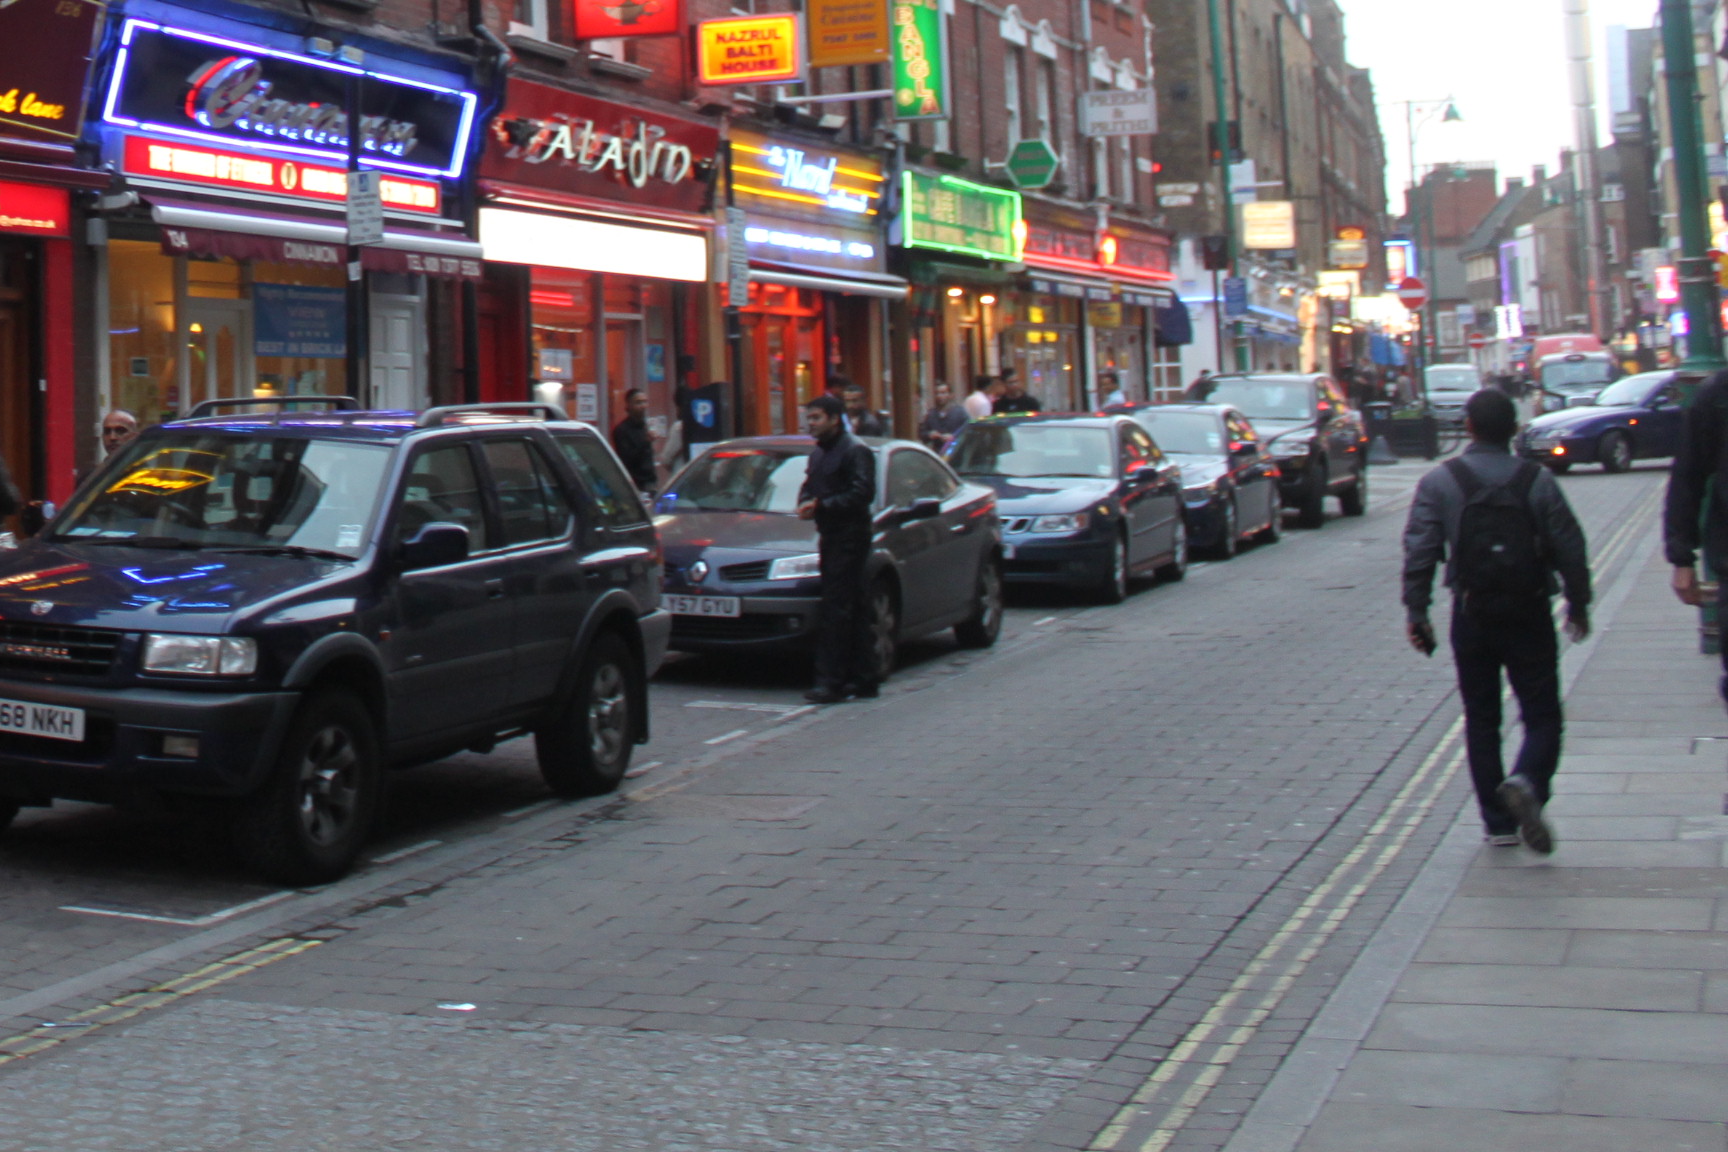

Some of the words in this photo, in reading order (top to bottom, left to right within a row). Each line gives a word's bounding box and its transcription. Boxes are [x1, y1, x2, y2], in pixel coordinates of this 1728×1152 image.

[716, 28, 783, 44] NAZRUL
[726, 44, 775, 59] BALTI
[894, 5, 941, 115] BANGLA
[19, 92, 65, 120] lane
[697, 401, 713, 426] P
[32, 706, 75, 736] NKH
